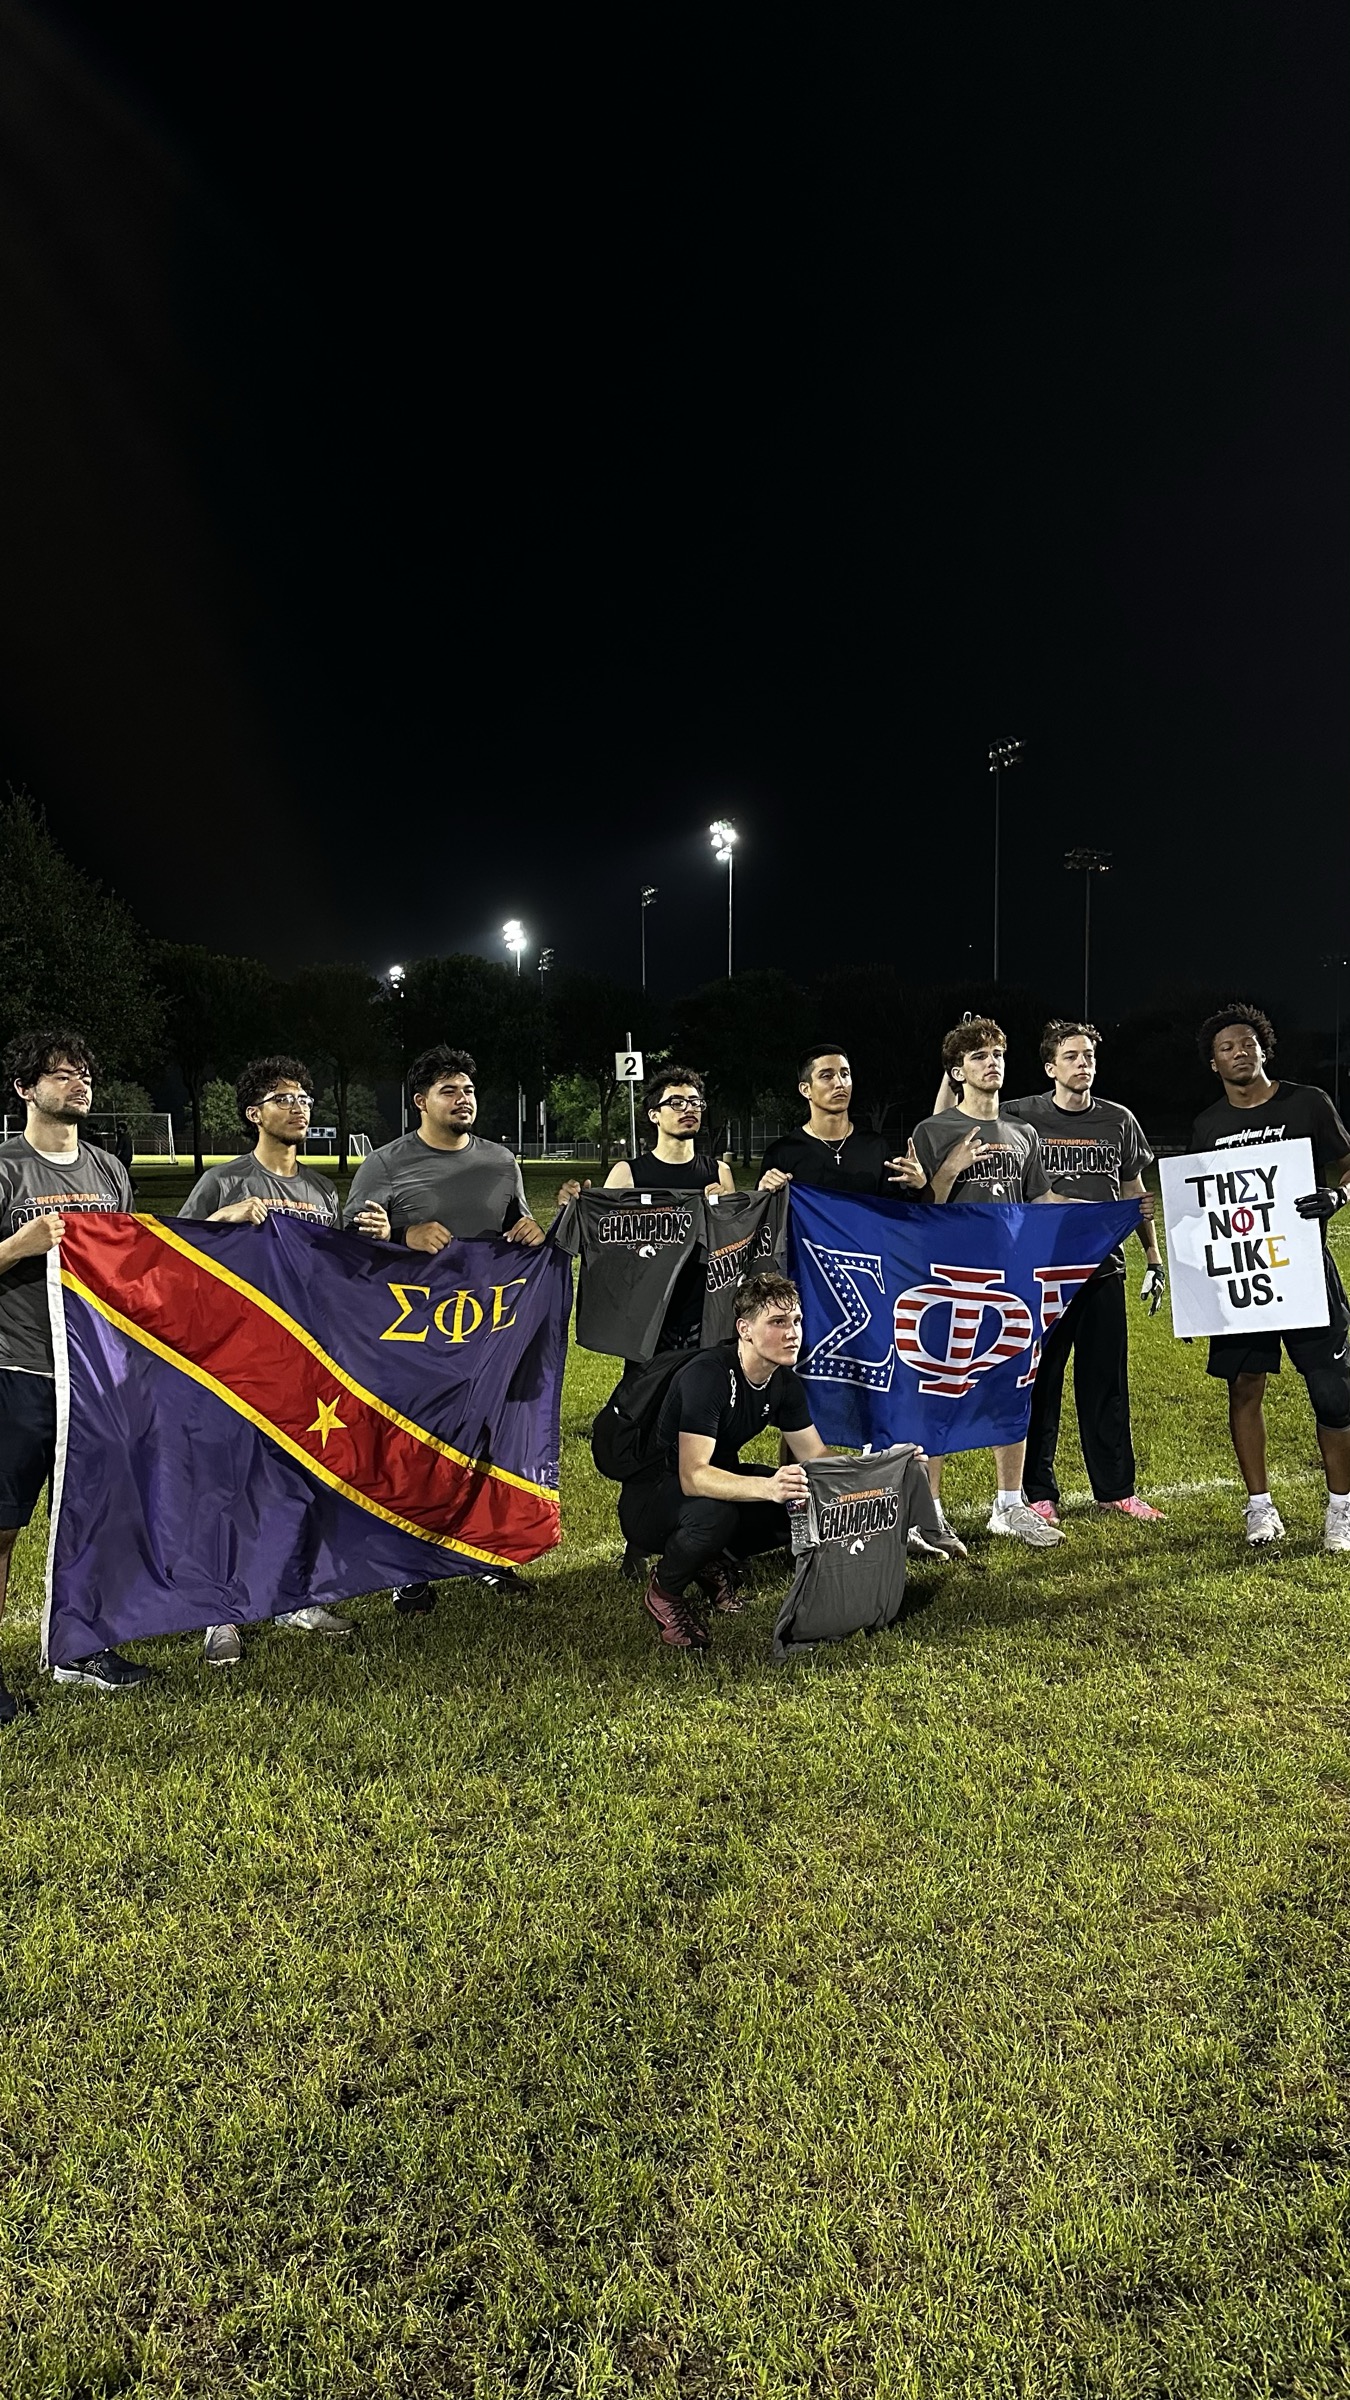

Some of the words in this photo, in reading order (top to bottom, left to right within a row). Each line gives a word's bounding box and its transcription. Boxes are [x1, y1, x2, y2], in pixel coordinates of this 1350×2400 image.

[624, 1056, 637, 1076] 2
[1048, 1138, 1099, 1146] INTRAMURAL
[1041, 1145, 1116, 1173] HAMPIONS
[35, 1193, 102, 1205] INTRAMURAL
[598, 1212, 693, 1244] CHAMPIONS
[1205, 1235, 1290, 1277] LIKE
[1227, 1274, 1283, 1308] US.
[819, 1494, 898, 1543] CHAMPIONS
